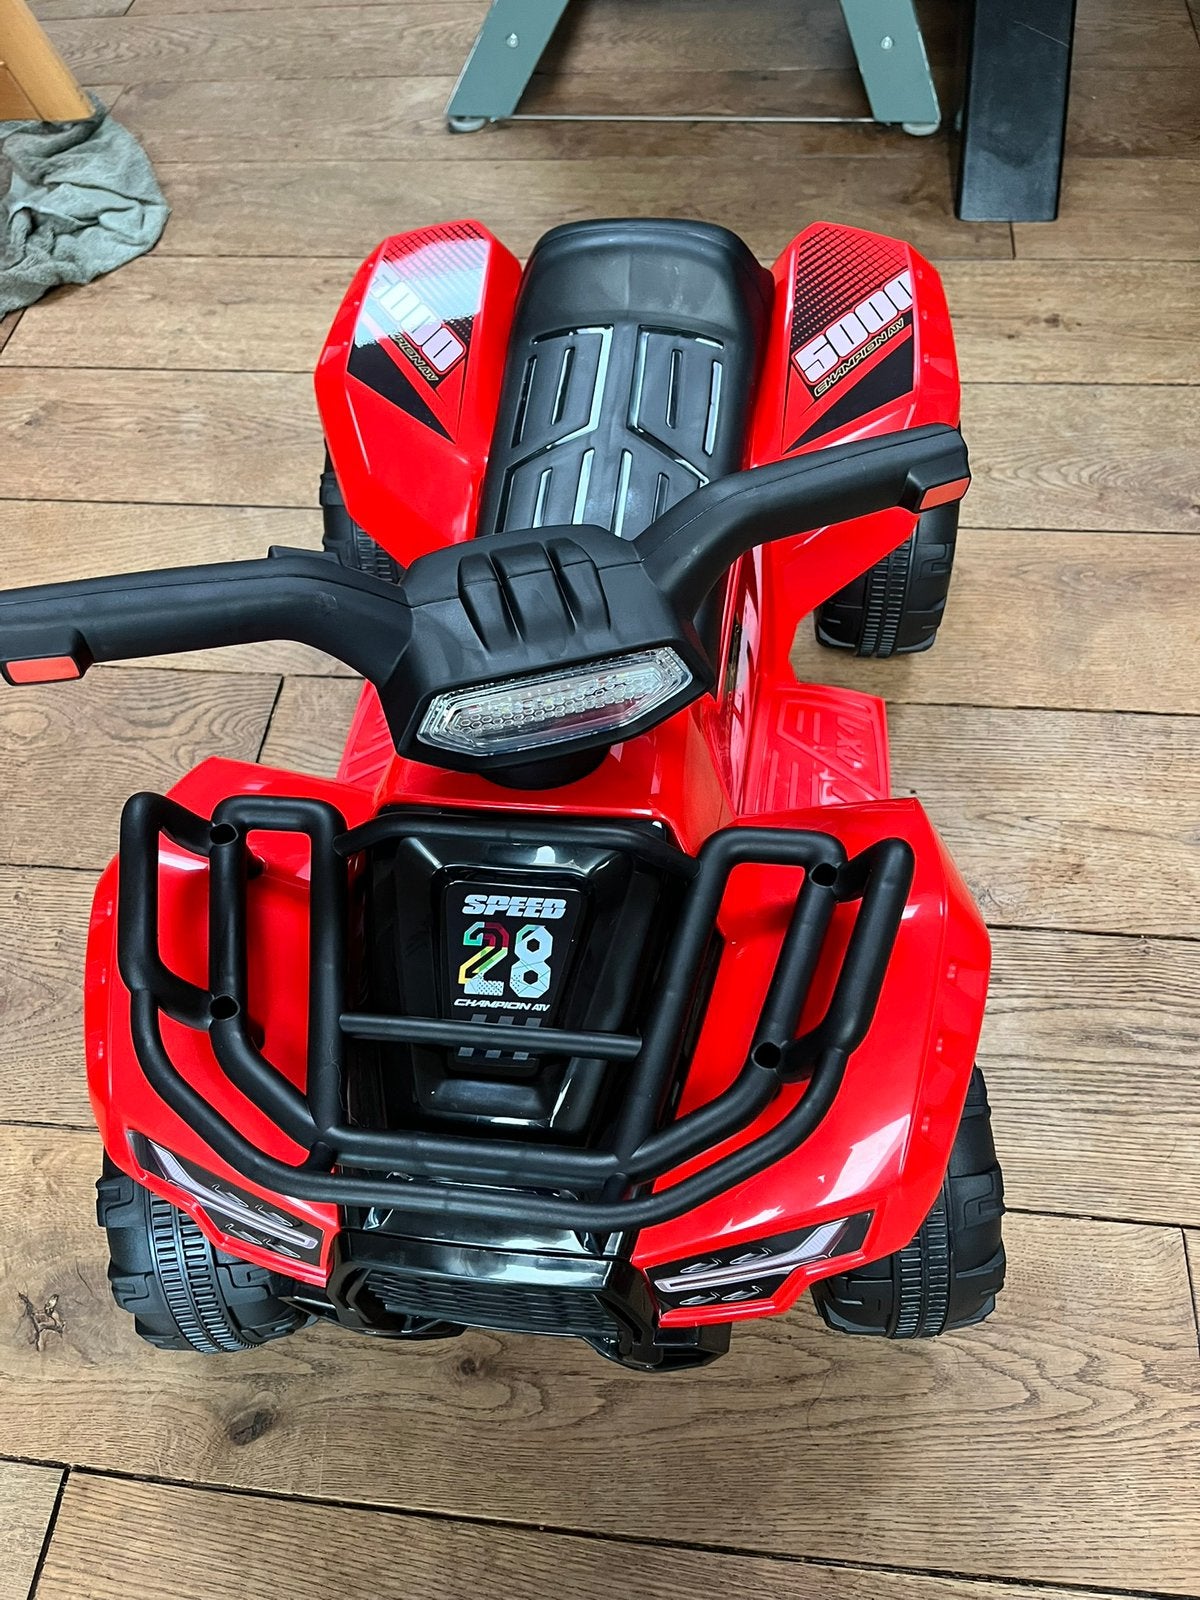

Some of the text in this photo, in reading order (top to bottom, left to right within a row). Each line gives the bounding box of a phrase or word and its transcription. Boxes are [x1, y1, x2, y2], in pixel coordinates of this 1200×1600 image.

[794, 270, 913, 383] 5000
[814, 334, 888, 397] CHAMPION
[462, 894, 567, 919] SPEED
[458, 921, 554, 998] 28
[454, 999, 550, 1012] CHAMPION ATV
